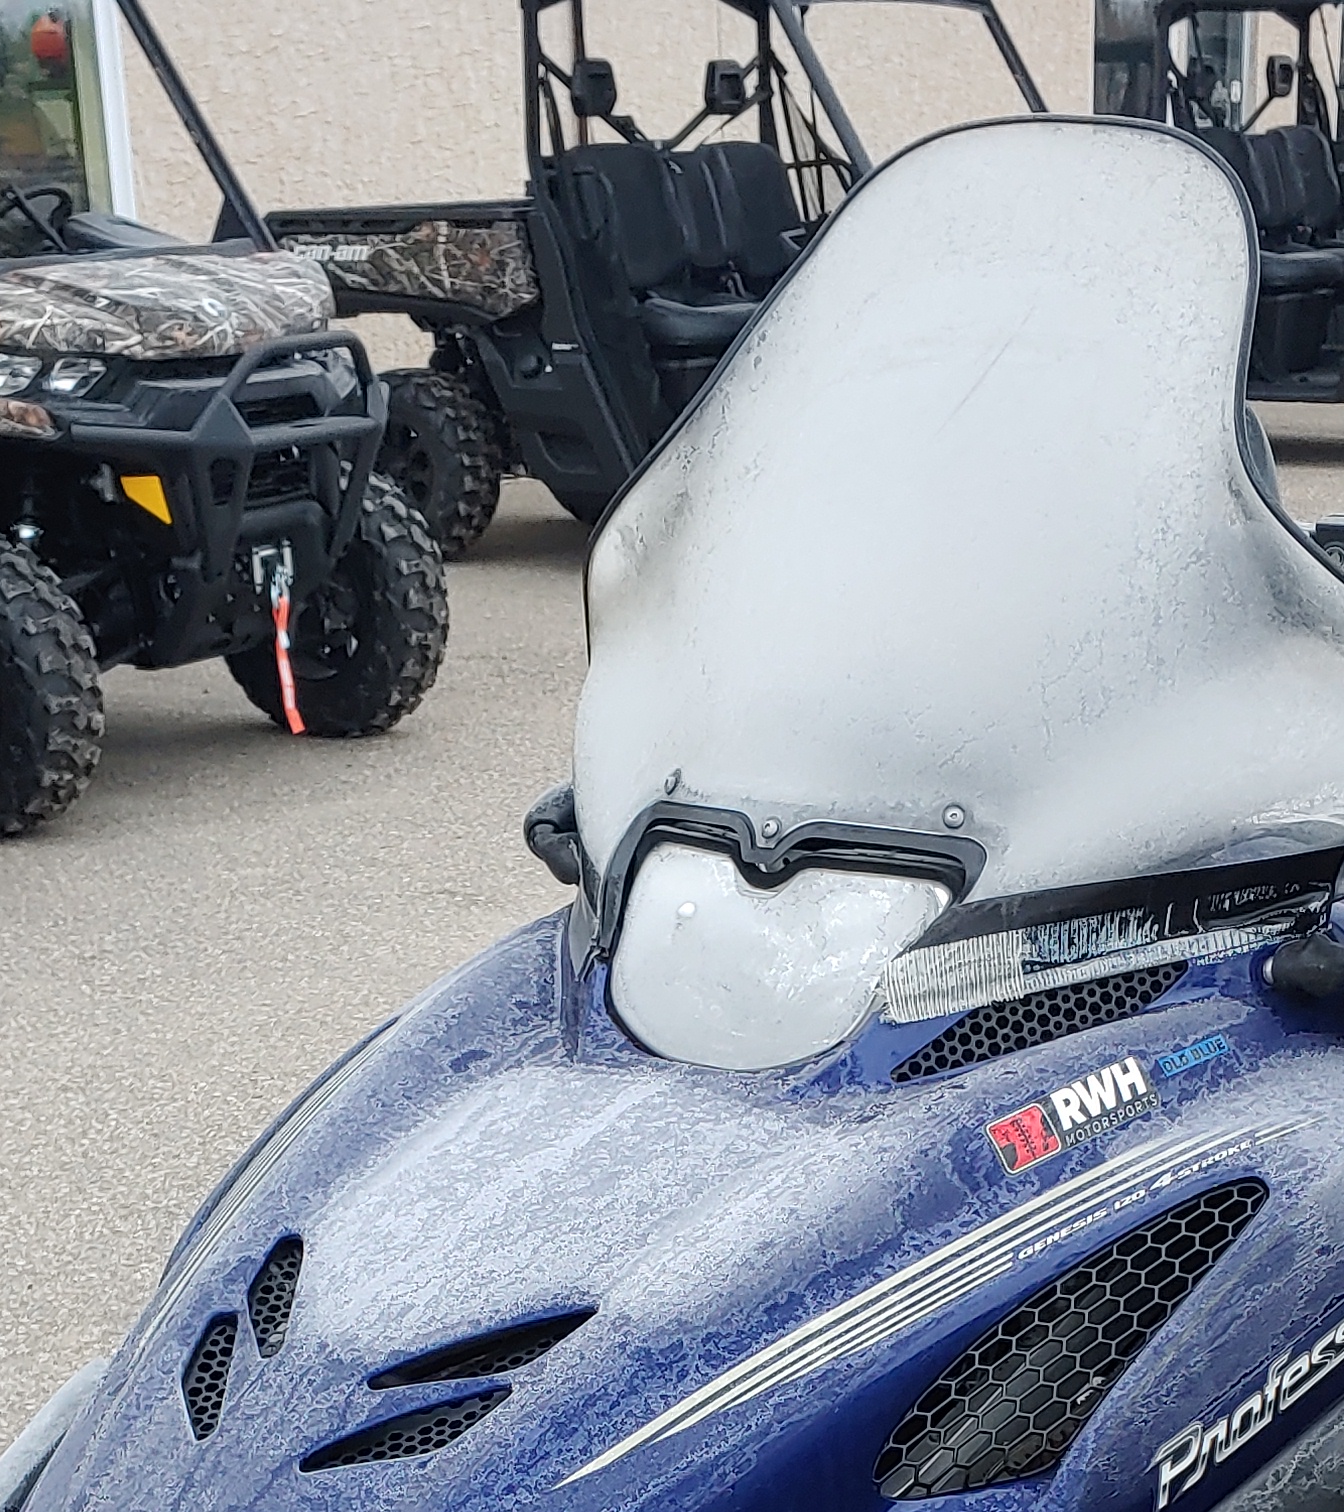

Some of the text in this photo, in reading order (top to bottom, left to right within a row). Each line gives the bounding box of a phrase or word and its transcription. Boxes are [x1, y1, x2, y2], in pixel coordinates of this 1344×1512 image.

[1049, 1056, 1148, 1132] RWH
[1065, 1094, 1159, 1148] MOTORSPORTS
[1017, 1208, 1109, 1261] GENESIS
